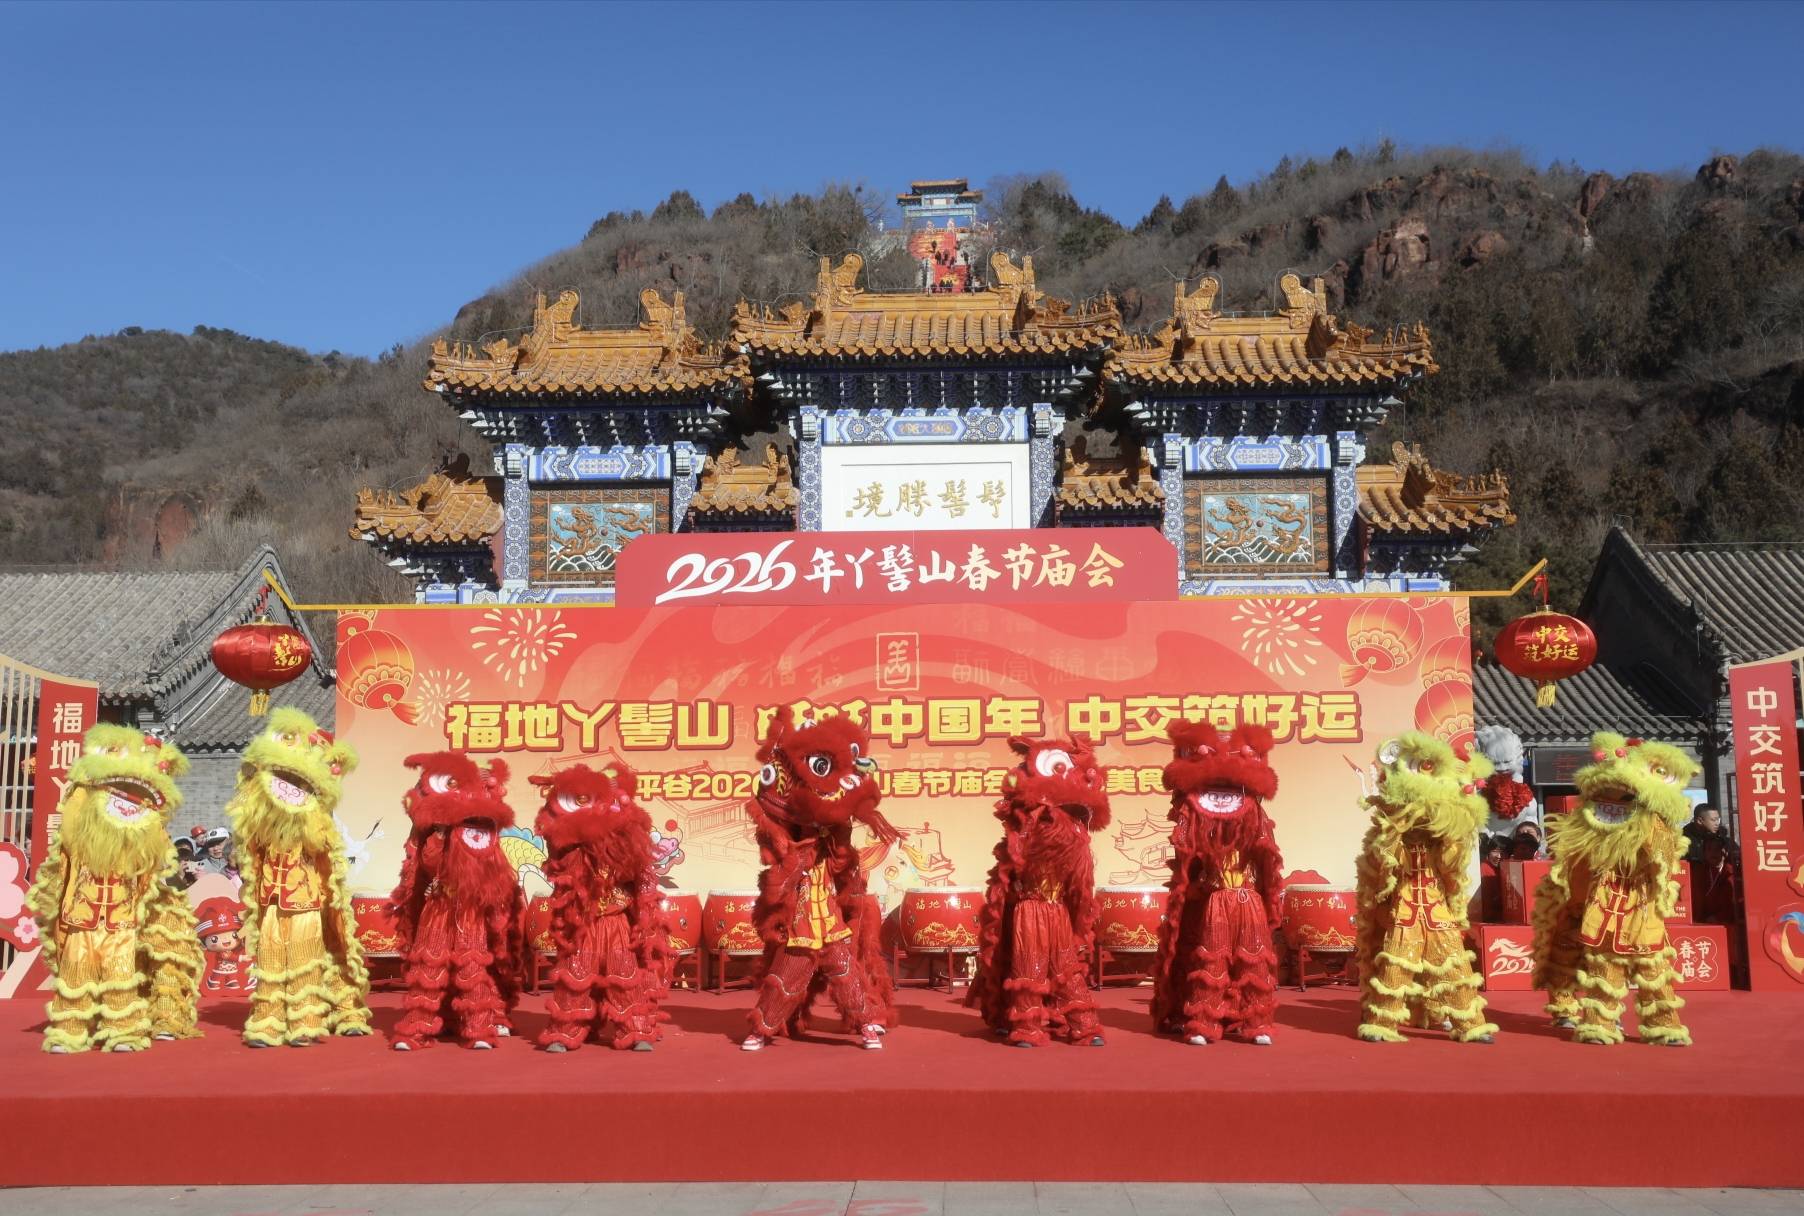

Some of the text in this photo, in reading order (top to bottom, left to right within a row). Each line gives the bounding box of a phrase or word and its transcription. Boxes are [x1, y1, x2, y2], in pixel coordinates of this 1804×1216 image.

[1535, 624, 1570, 644] 中交
[1523, 643, 1579, 662] 筑好运
[447, 701, 731, 749] 福地丫髻山
[757, 699, 1041, 744] 中国年
[1747, 686, 1791, 872] 中交筑好运
[1678, 940, 1712, 959] 春节
[1681, 960, 1713, 978] 庙会
